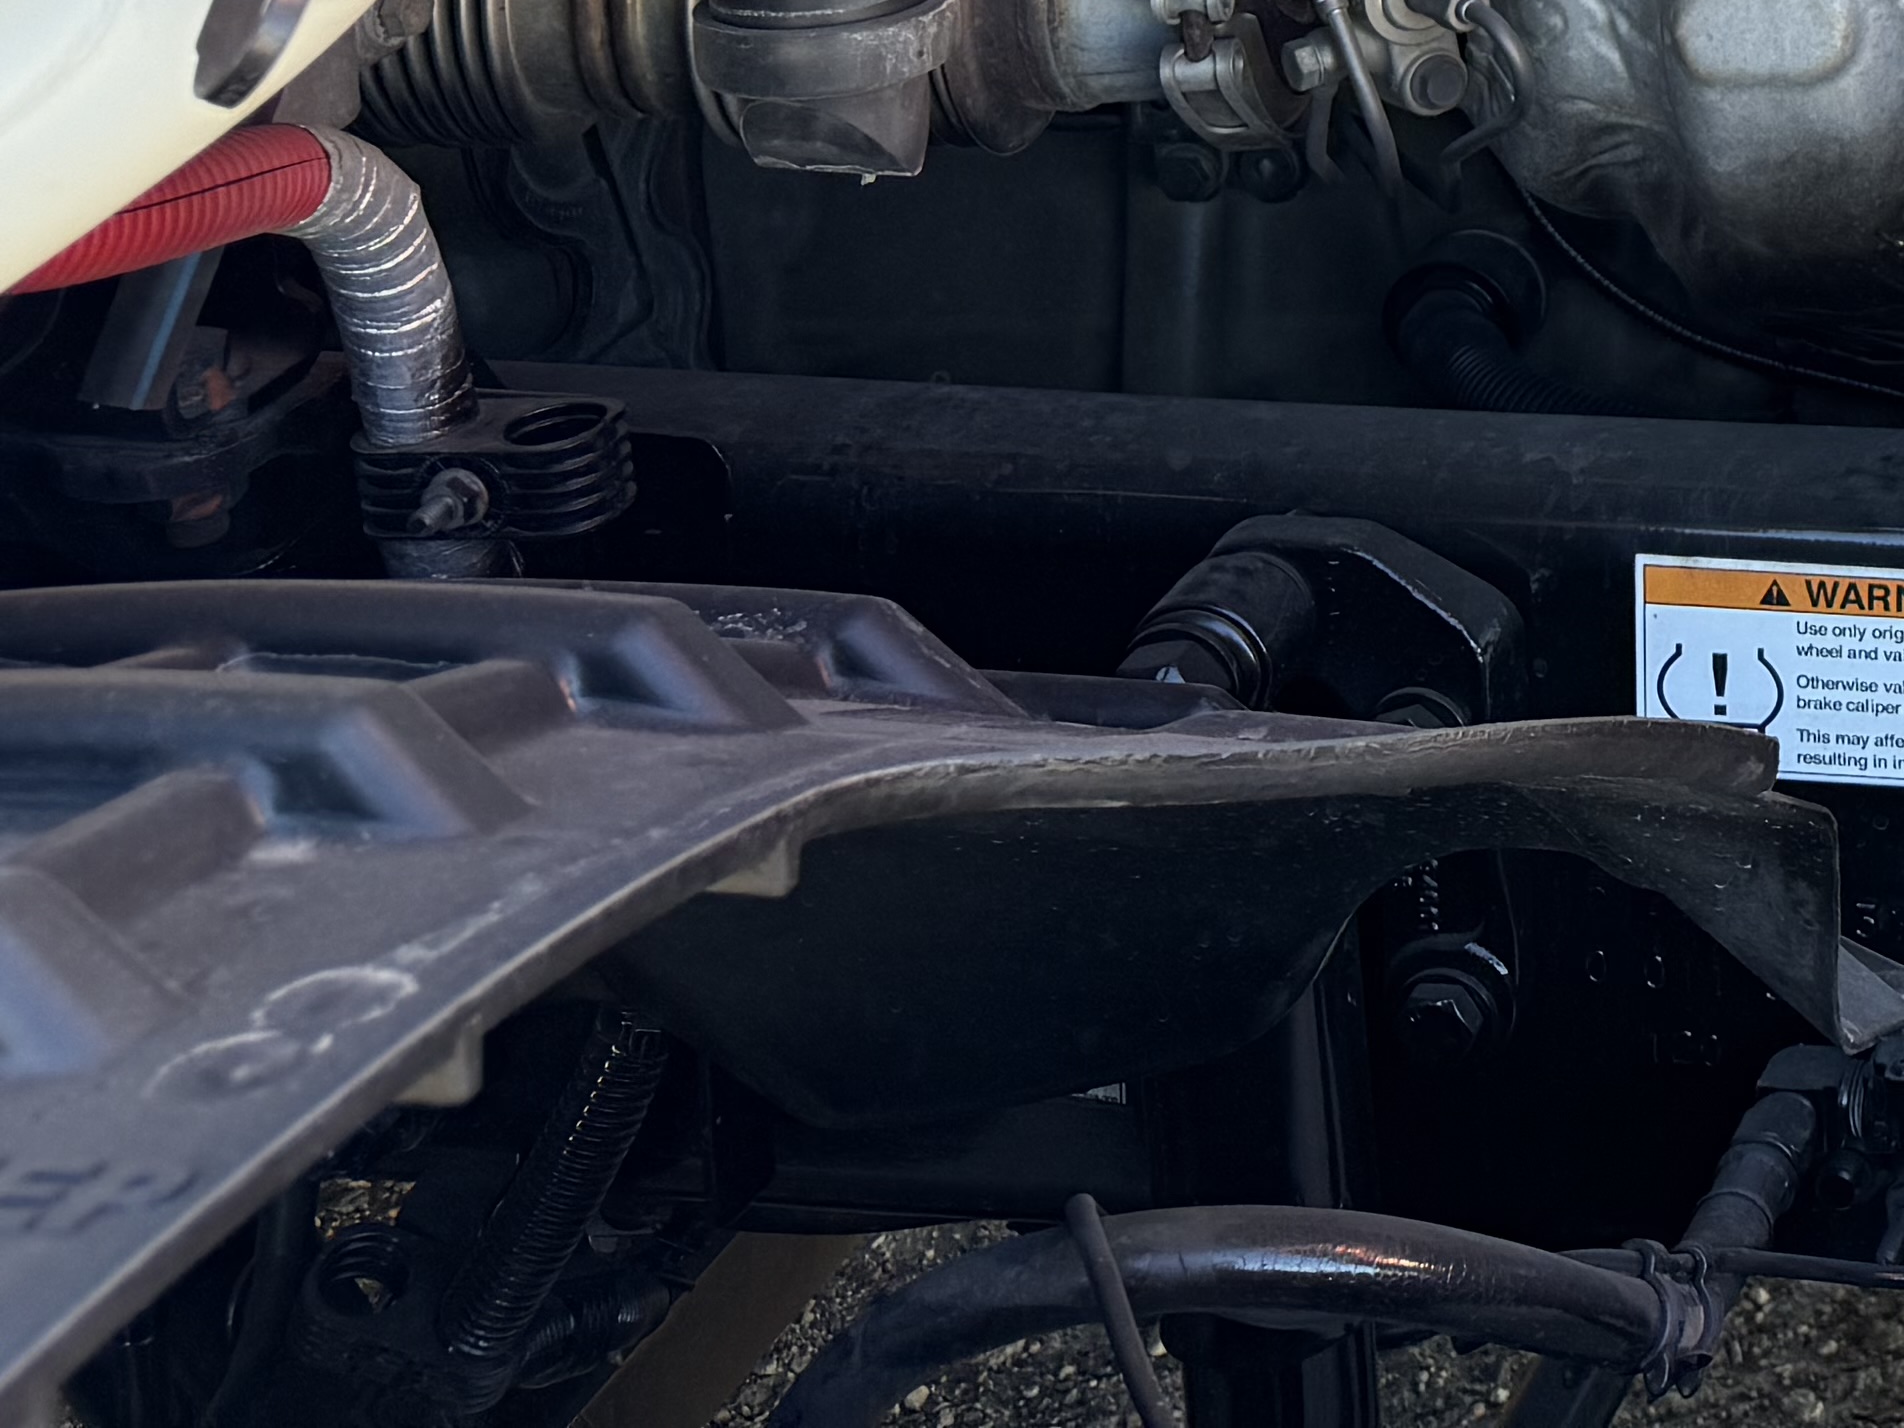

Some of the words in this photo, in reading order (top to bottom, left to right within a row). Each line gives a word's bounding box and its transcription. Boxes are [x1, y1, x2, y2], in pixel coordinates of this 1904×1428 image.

[1796, 621, 1826, 638] Use
[1832, 624, 1867, 643] only
[1796, 643, 1843, 660] wheel
[1848, 646, 1878, 662] and
[1796, 674, 1878, 694] Otherwise
[1796, 695, 1842, 712] brake
[1846, 698, 1901, 716] caliper
[1796, 728, 1831, 746] This
[1835, 733, 1870, 751] may
[1796, 750, 1868, 771] resulting
[1874, 753, 1887, 769] in
